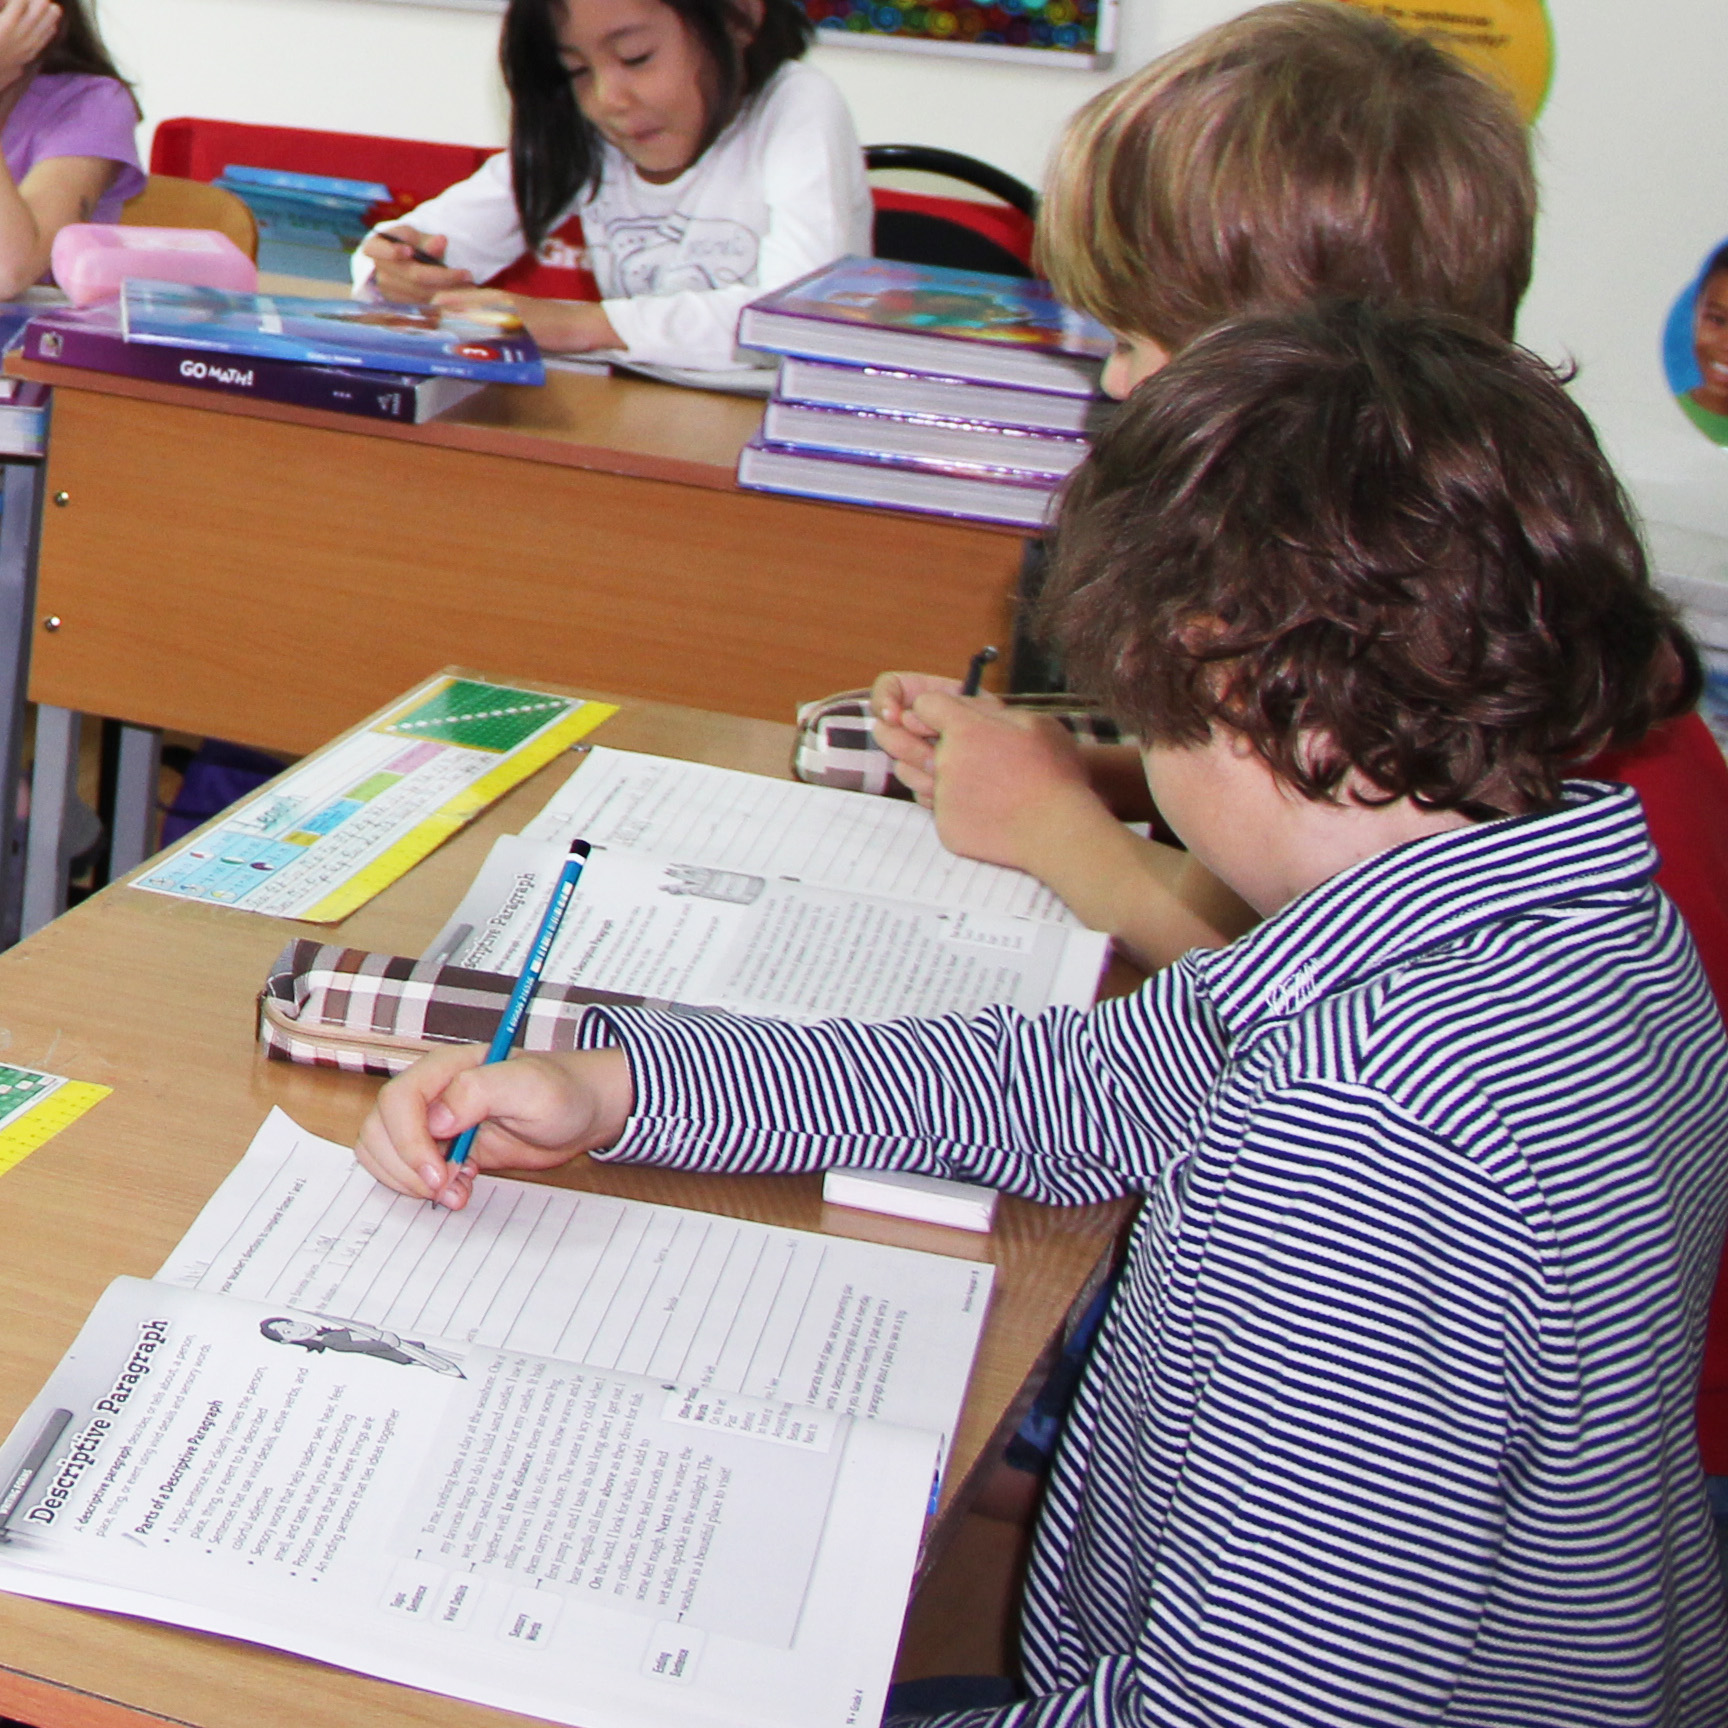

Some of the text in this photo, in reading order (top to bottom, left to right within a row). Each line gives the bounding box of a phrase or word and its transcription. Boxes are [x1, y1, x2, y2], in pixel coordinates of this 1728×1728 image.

[179, 359, 254, 387] GO MATH!
[461, 925, 502, 970] scriptive
[489, 871, 536, 928] Paragraph
[29, 1319, 173, 1524] Descriptive Paragraph
[76, 1482, 109, 1524] descriptive
[104, 1445, 131, 1482] paragraph
[150, 1392, 164, 1404] tells
[126, 1466, 140, 1484] event
[140, 1448, 155, 1464] using
[151, 1432, 164, 1447] vivid
[159, 1410, 176, 1431] details
[174, 1395, 184, 1408] and
[180, 1369, 200, 1394] sensory
[134, 1510, 159, 1534] Parts
[150, 1498, 165, 1509] of
[159, 1446, 197, 1492] Descriptive
[187, 1400, 222, 1444] Paragraph
[172, 1507, 190, 1524] topic
[185, 1476, 208, 1506] sentence
[202, 1459, 217, 1474] that
[212, 1436, 232, 1458] clearly
[226, 1411, 244, 1434] names
[238, 1396, 251, 1408] the
